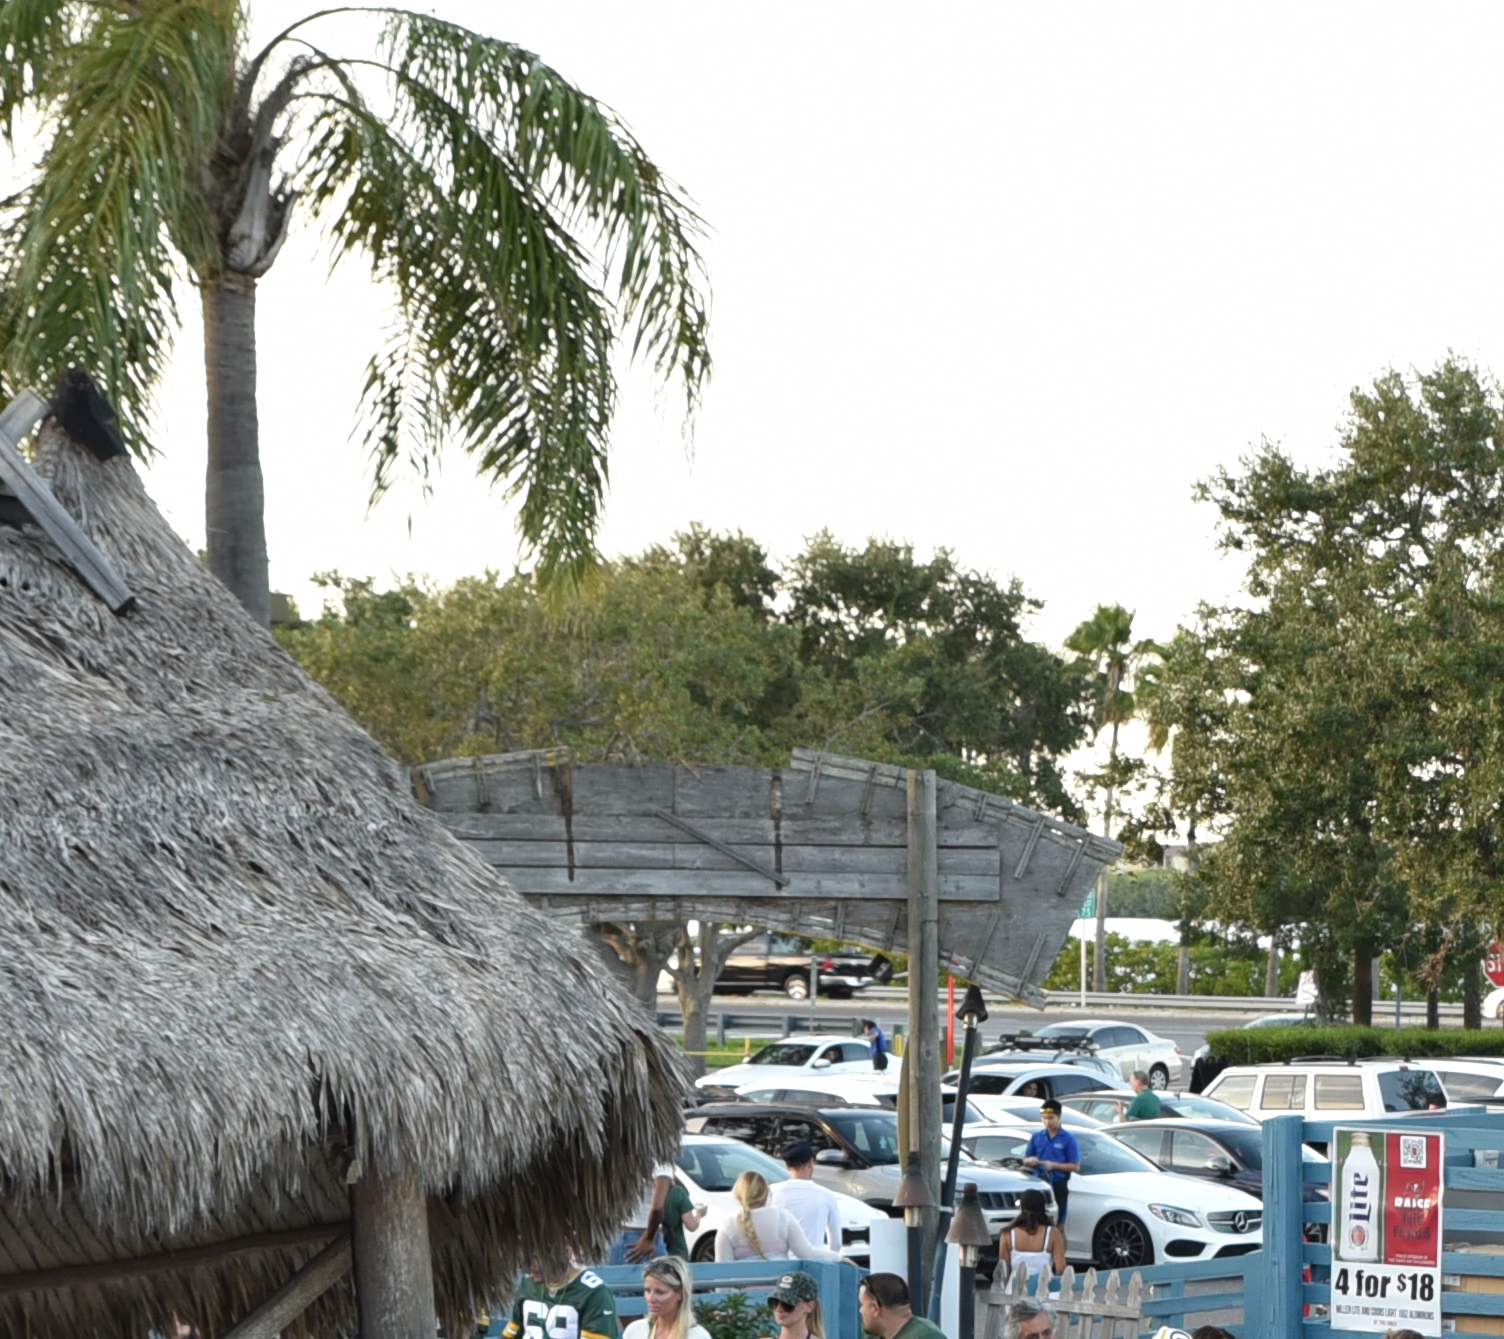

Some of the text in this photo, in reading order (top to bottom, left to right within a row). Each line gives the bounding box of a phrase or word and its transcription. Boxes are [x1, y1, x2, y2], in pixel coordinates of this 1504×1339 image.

[1348, 1171, 1372, 1223] Lite
[1334, 1267, 1435, 1302] 4 for $18
